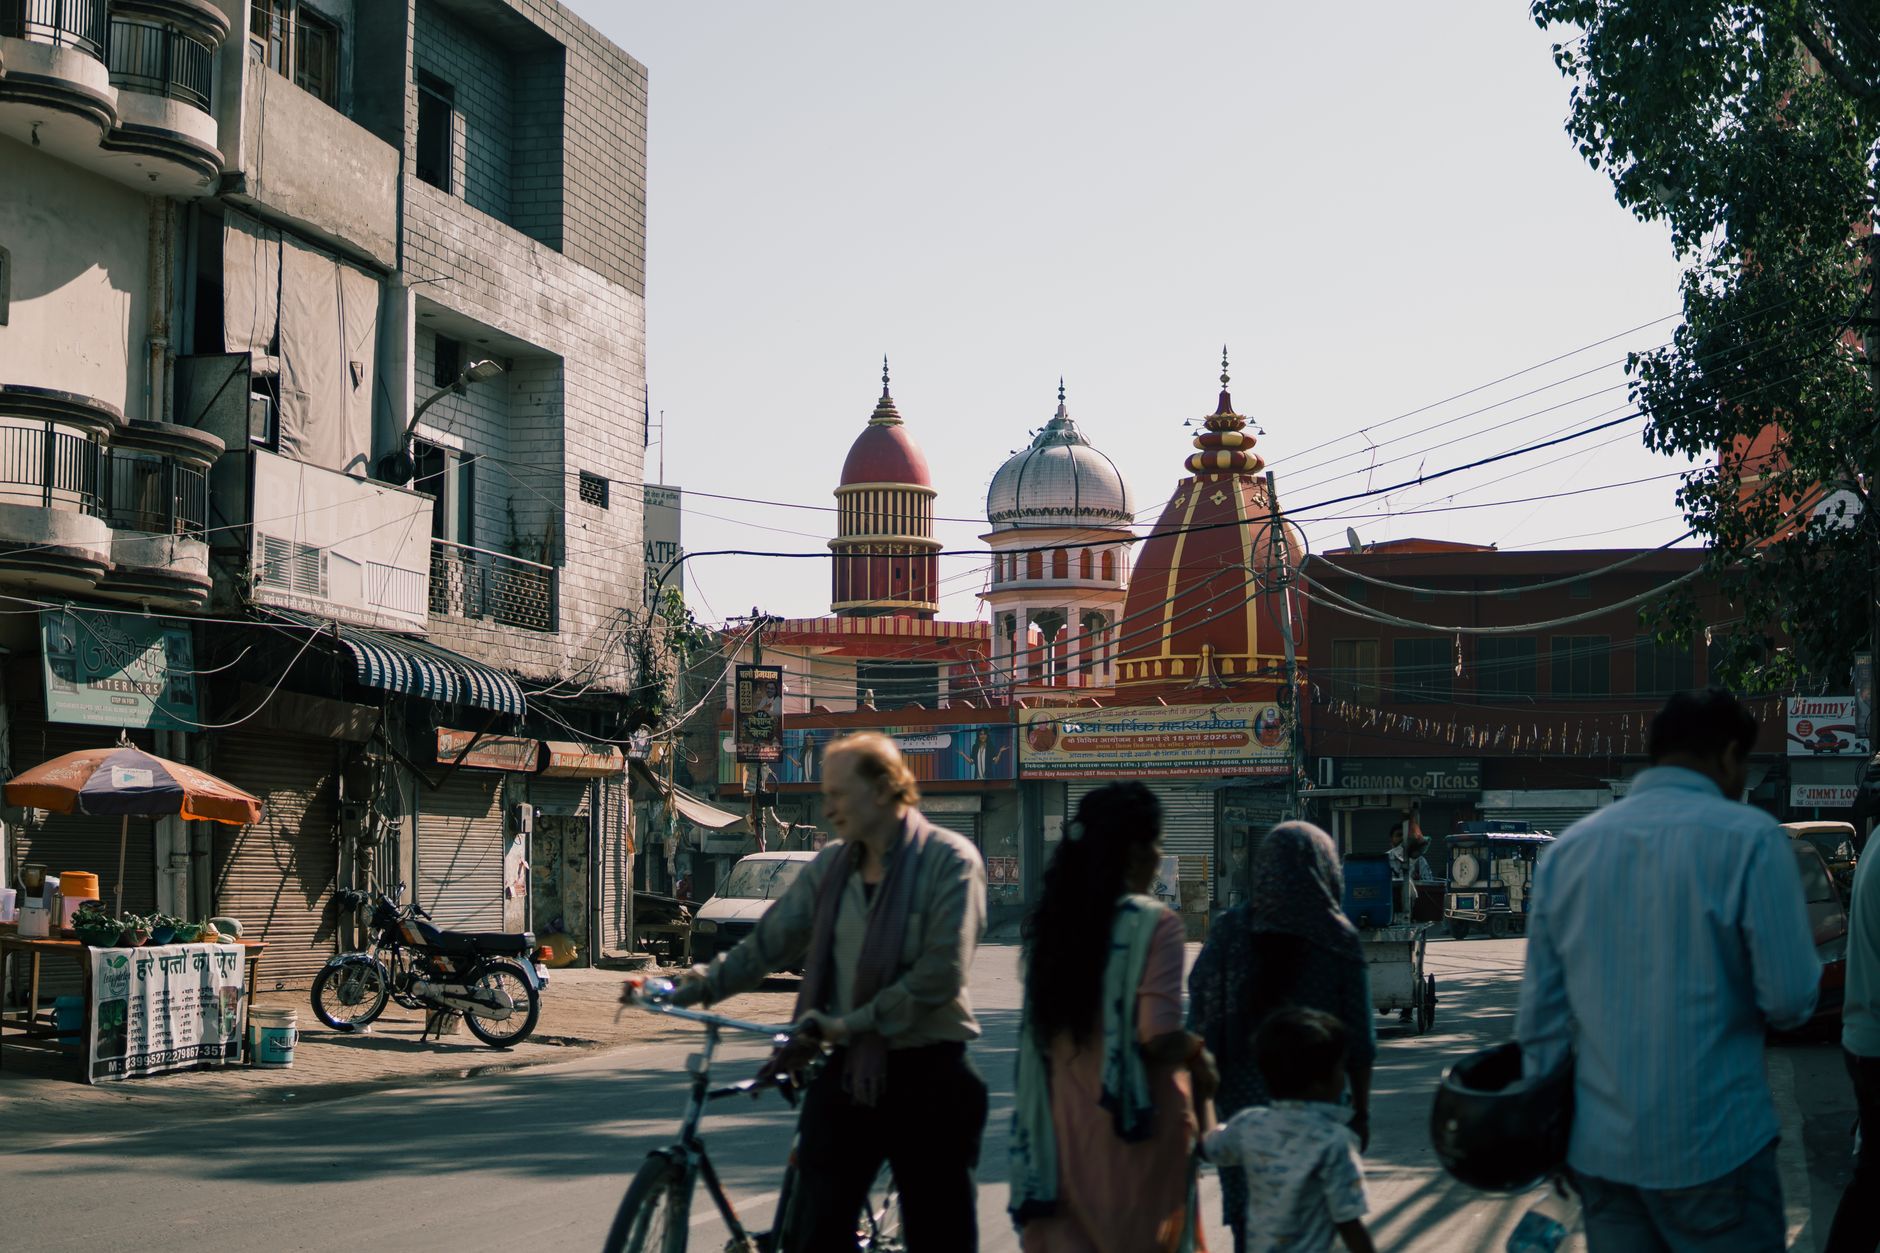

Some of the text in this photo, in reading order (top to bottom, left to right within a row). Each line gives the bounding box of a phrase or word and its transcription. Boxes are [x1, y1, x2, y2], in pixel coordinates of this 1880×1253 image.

[644, 540, 677, 565] ATH
[90, 680, 159, 694] INTERIORS
[1342, 772, 1479, 788] CHAMAN OPTICALS
[1807, 788, 1858, 800] JIMMY LOC
[136, 948, 238, 982] हरे पत्तों का जूस
[108, 1061, 122, 1072] M:
